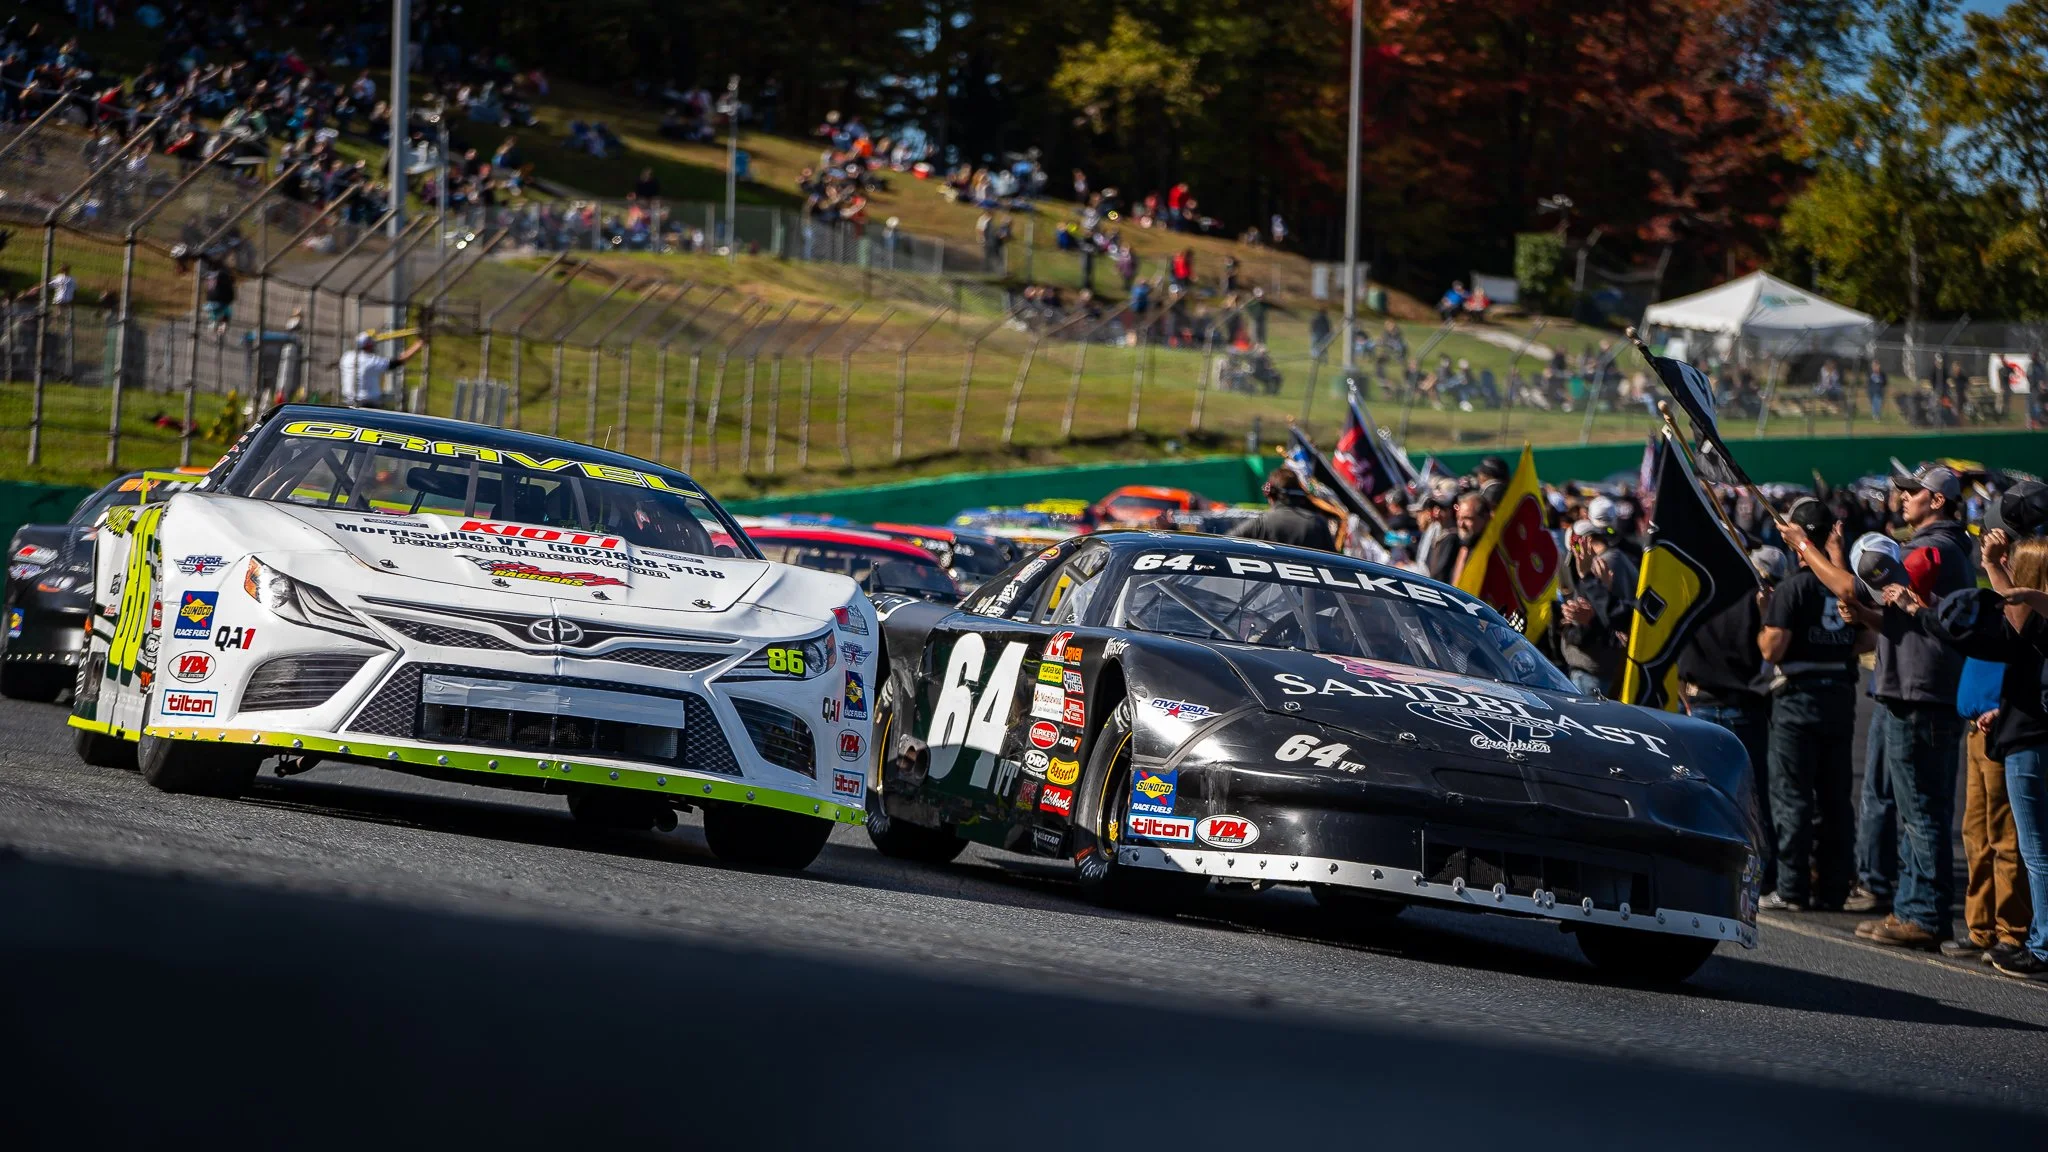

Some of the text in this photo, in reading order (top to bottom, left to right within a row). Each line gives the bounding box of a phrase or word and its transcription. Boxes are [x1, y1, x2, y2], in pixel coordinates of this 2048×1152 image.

[280, 420, 706, 500] GRAVEL
[460, 520, 620, 549] KIOTI
[498, 537, 529, 548] VT
[184, 555, 222, 565] FIVE STAR
[490, 569, 586, 587] RACECARS
[1132, 554, 1195, 571] 64
[1225, 556, 1484, 617] PELKEY
[182, 604, 212, 616] SUNOCO
[175, 628, 211, 638] RACE FUELS
[215, 625, 256, 652] QA1
[179, 655, 211, 674] VDL
[767, 647, 806, 677] 86
[168, 693, 213, 713] tilton
[821, 696, 841, 723] QA1
[927, 632, 1029, 790] 64
[1151, 698, 1208, 716] FIVE STAR
[1273, 673, 1671, 758] SANDBLAST
[840, 733, 860, 753] VDL
[1470, 733, 1551, 754] Graphics
[1027, 754, 1049, 768] DRP
[1274, 734, 1366, 774] 64 VT
[993, 758, 1021, 797] VT
[1050, 762, 1076, 781] Bassett
[834, 773, 861, 795] tilton
[1137, 780, 1171, 794] SUNOCO
[1132, 802, 1173, 815] RACE FUELS
[1132, 817, 1191, 838] tilton
[1209, 819, 1248, 838] VDL
